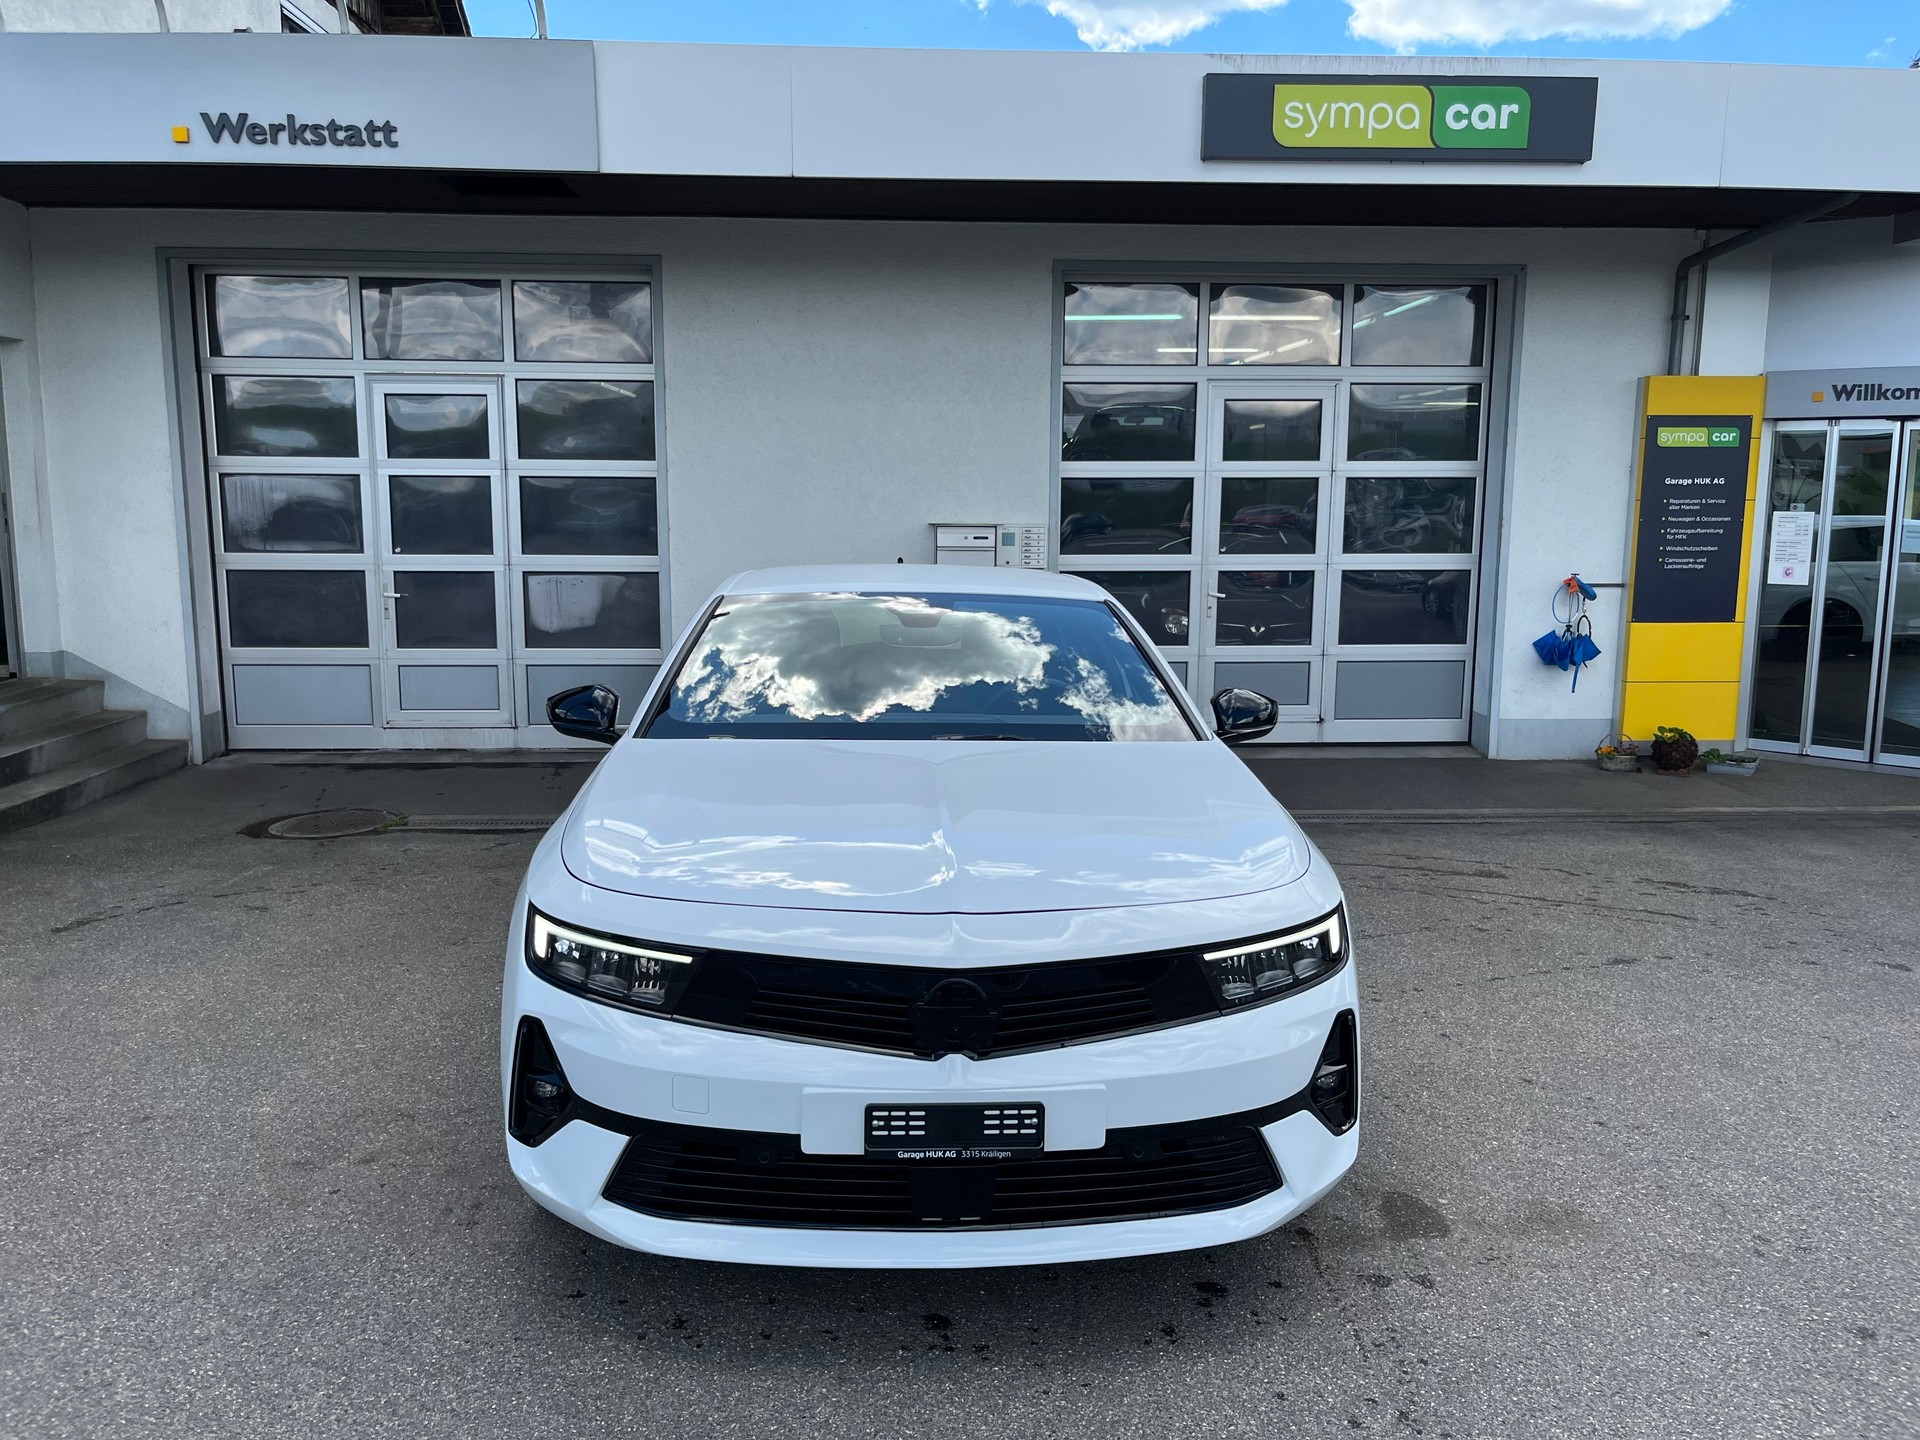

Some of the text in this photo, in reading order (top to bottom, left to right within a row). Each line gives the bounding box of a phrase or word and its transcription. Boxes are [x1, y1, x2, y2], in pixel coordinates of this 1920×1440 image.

[1283, 101, 1519, 139] sympa car
[199, 112, 399, 148] Werkstatt
[1660, 431, 1736, 444] sympa car
[1664, 477, 1725, 485] Garage HUK AG
[897, 1150, 924, 1159] Garage
[925, 1150, 944, 1158] HUK
[944, 1150, 957, 1158] AG
[961, 1150, 980, 1158] 3315
